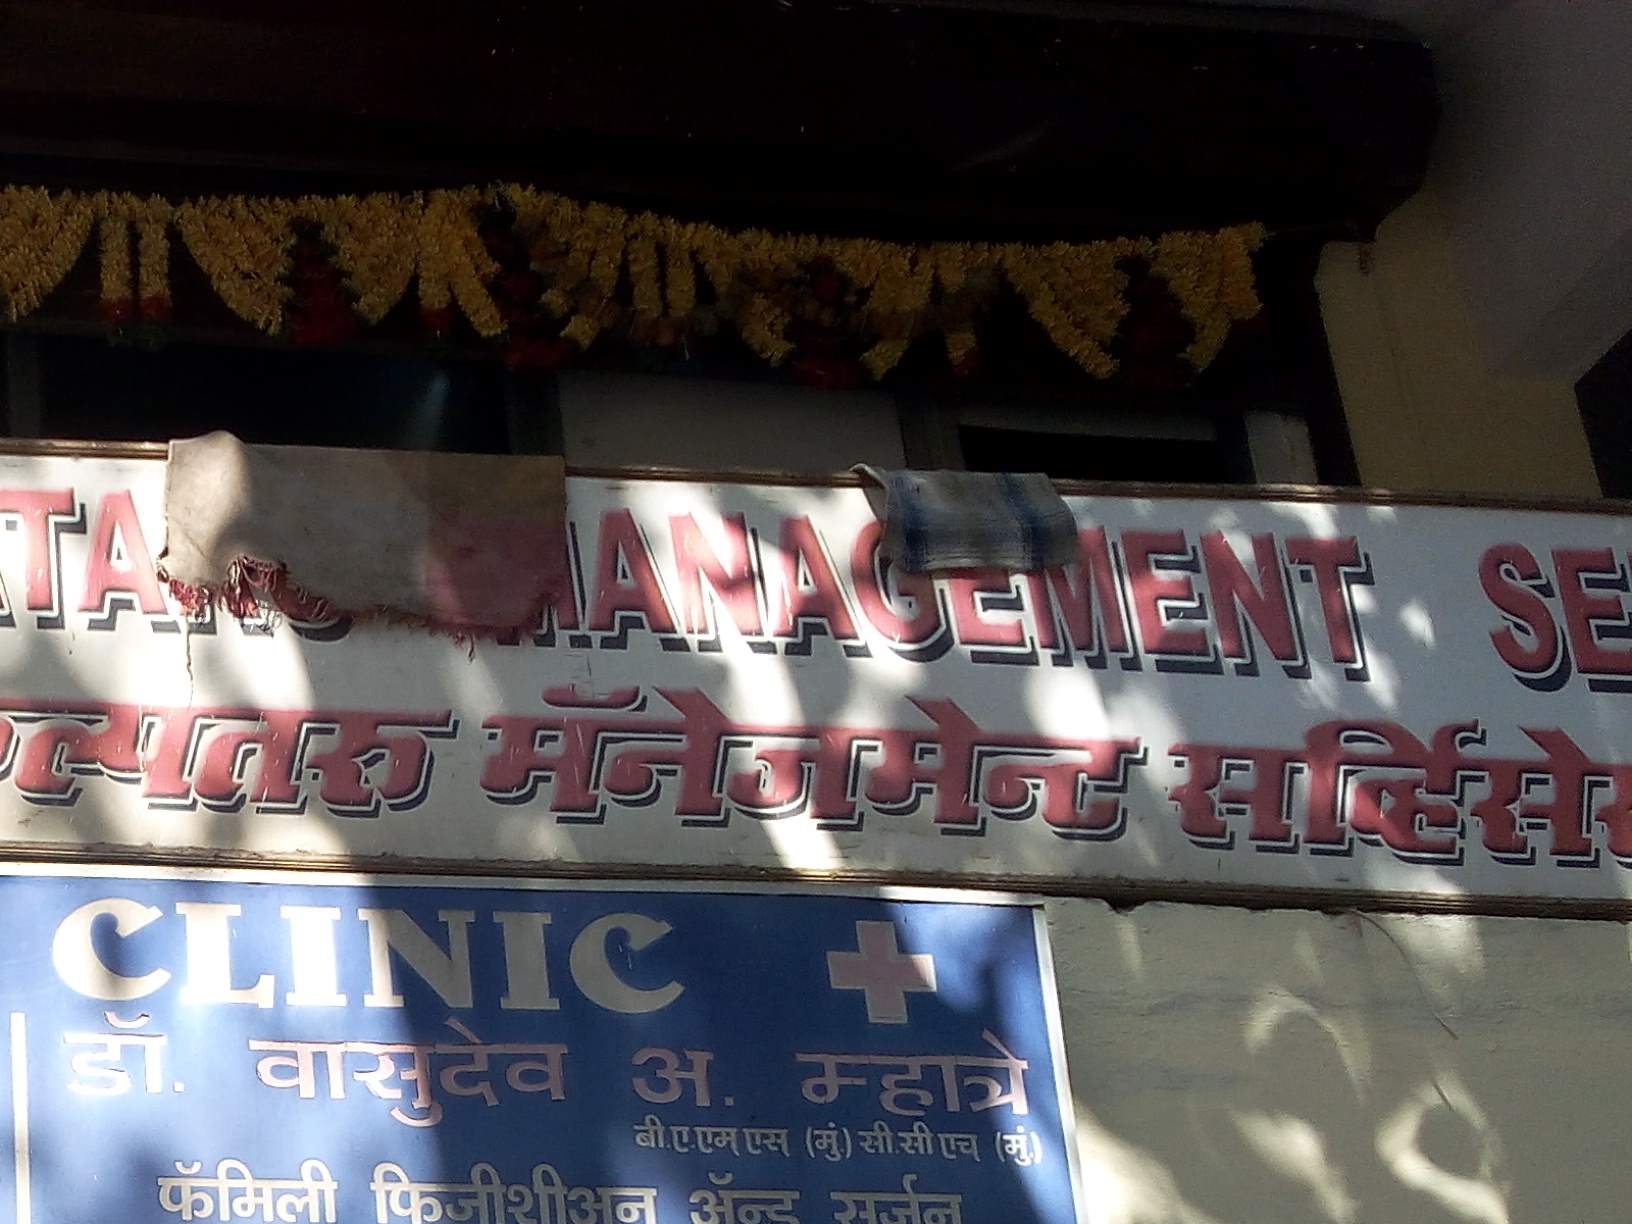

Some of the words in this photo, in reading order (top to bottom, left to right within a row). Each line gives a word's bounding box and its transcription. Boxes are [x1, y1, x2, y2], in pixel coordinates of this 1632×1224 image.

[496, 506, 1374, 682] ANAGEMENT
[52, 897, 686, 1015] CLINIC
[64, 1011, 185, 1097] डॉ.
[248, 1017, 568, 1128] वासुदेव
[631, 1047, 735, 1107] अ.
[795, 1029, 1030, 1117] म्हात्रे
[157, 1159, 338, 1224] फॅमिली
